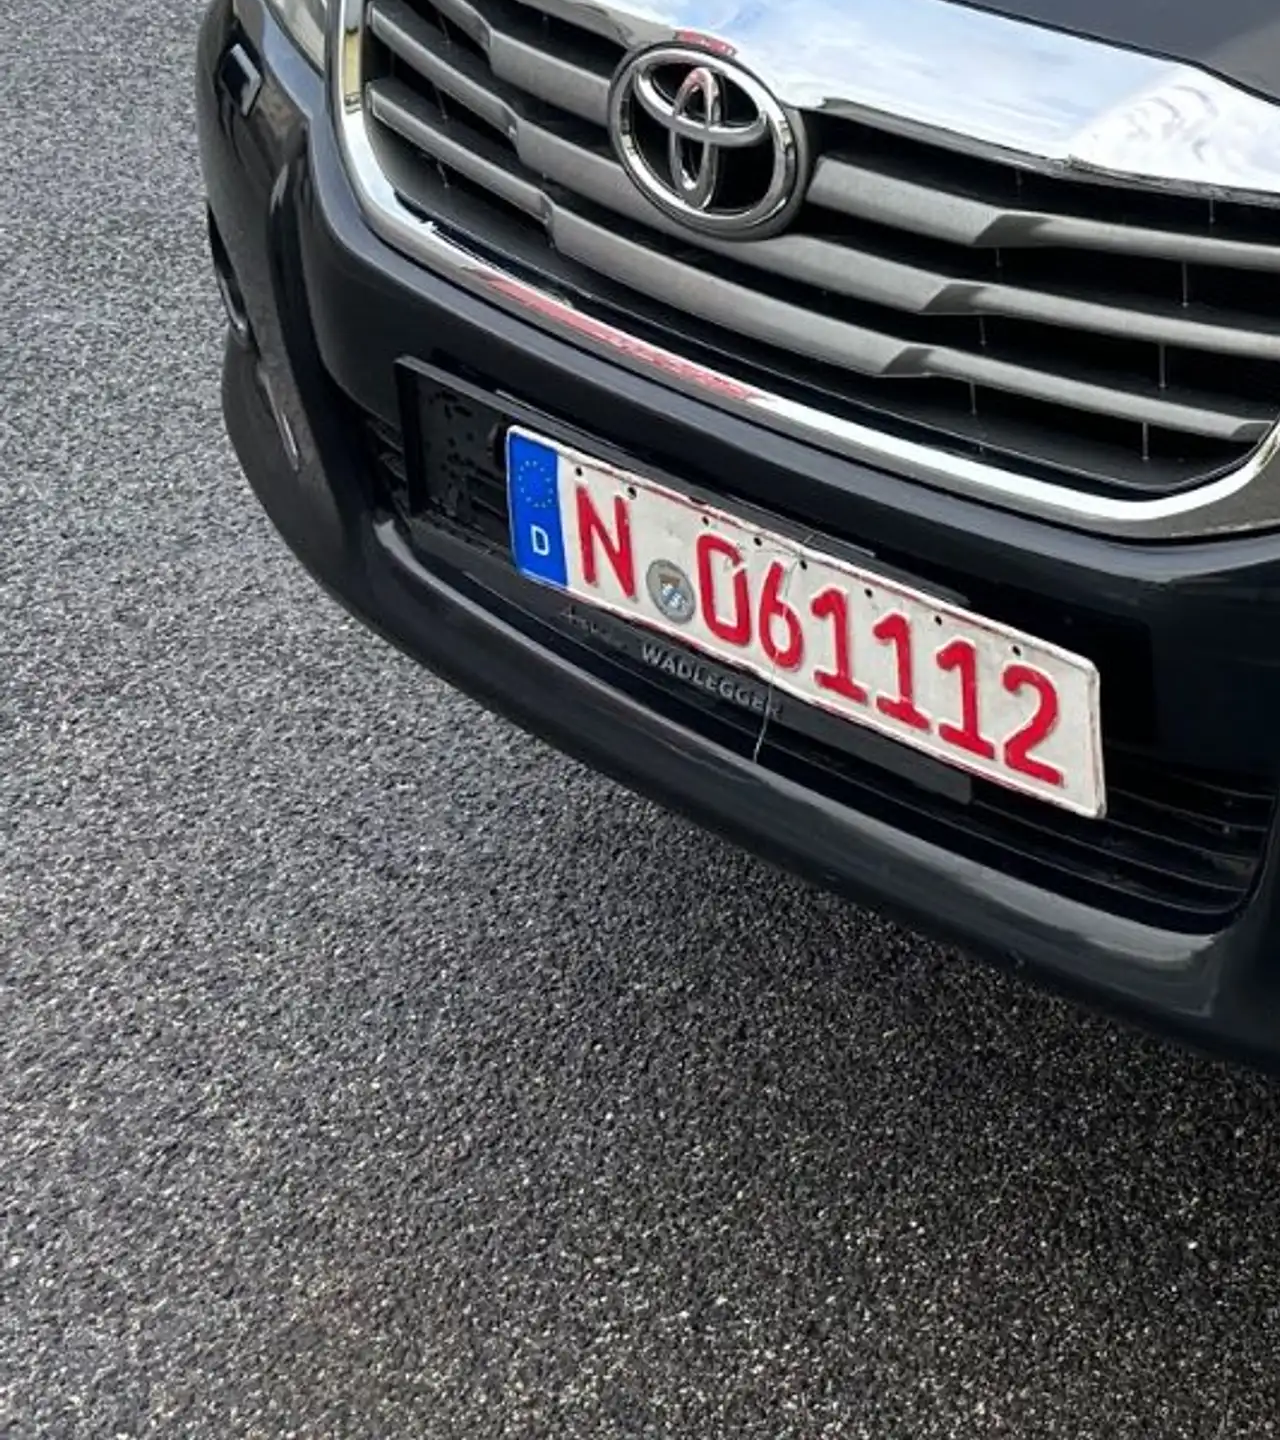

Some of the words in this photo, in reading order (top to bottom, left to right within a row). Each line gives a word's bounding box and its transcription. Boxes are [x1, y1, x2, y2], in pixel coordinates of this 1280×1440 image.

[530, 524, 549, 556] D
[575, 484, 637, 600] N
[696, 533, 1066, 788] 061112
